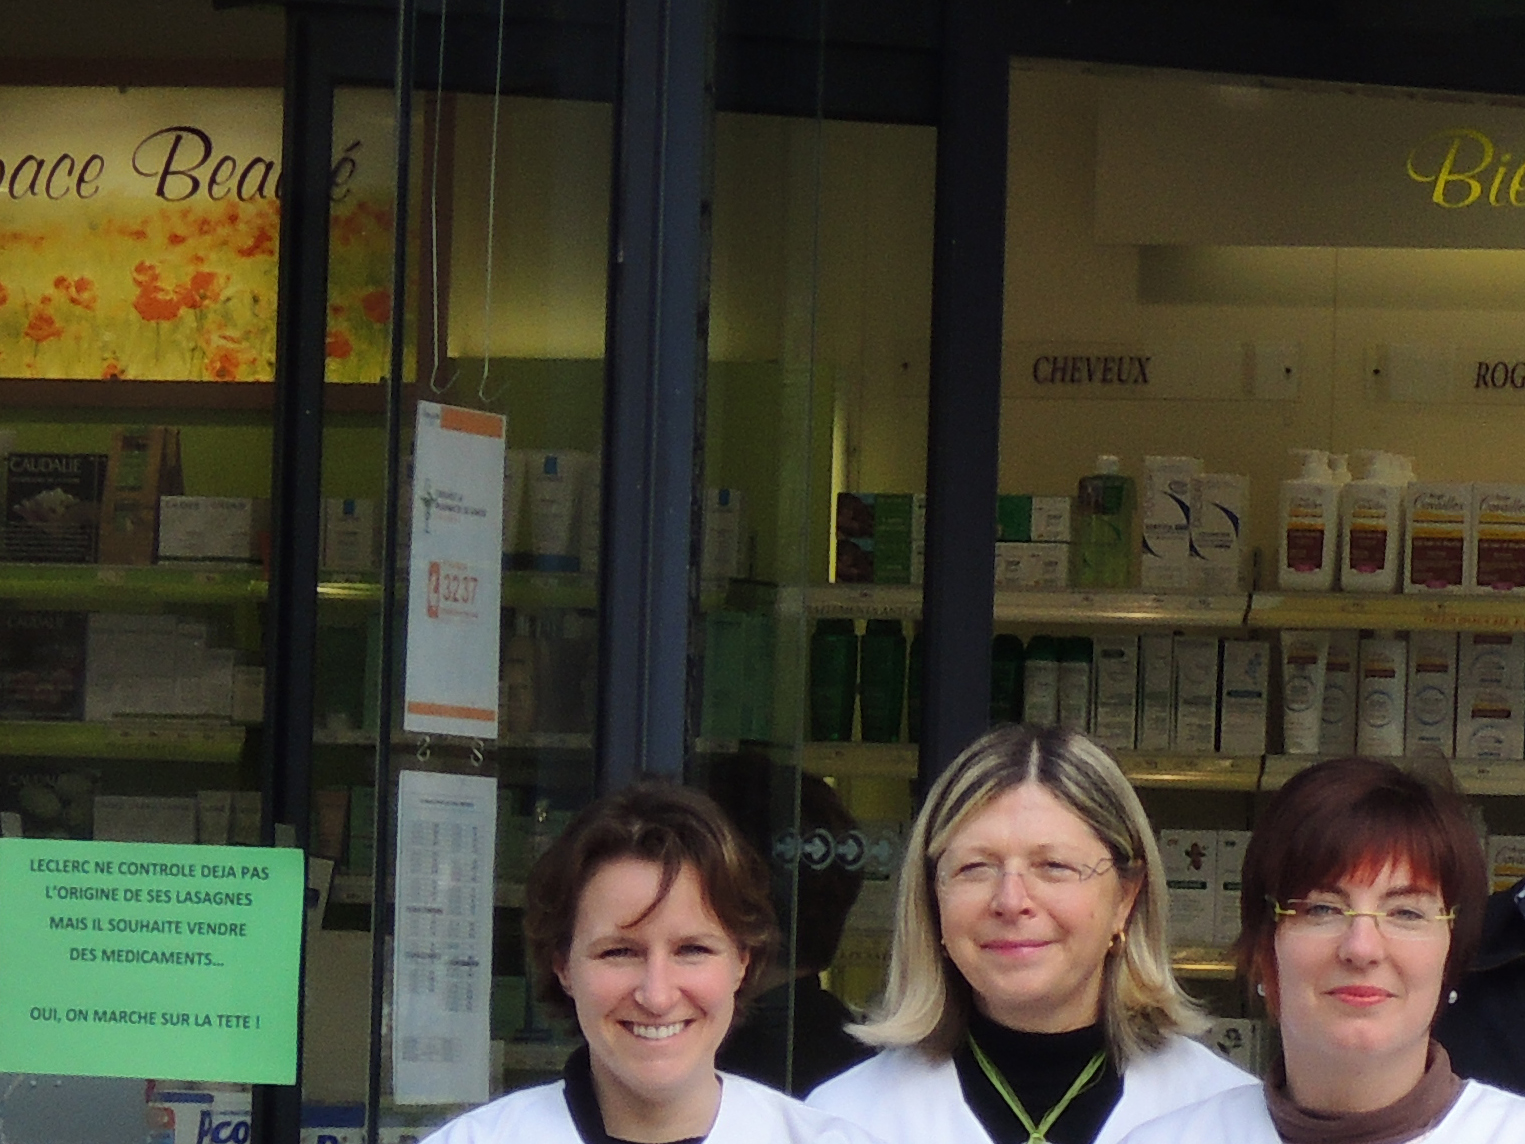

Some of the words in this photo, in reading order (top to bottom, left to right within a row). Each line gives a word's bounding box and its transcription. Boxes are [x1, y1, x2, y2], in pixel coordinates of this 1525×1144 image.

[0, 153, 105, 200] ace
[131, 125, 362, 202] Beaé
[1031, 354, 1152, 386] CHEVEUX
[10, 456, 82, 474] CAUDALIE
[30, 858, 90, 874] LECLERC
[95, 860, 114, 874] NE
[118, 861, 196, 877] CONTROLE
[201, 864, 236, 879] DEJA
[241, 866, 270, 881] PAS
[45, 885, 119, 902] L'ORIGINE
[124, 889, 143, 902] DE
[147, 889, 171, 904] SES
[176, 890, 253, 907] LASAGNES
[49, 917, 87, 931] MAIS
[92, 918, 104, 931] IL
[108, 918, 182, 934] SOUHAITE
[187, 922, 247, 937] VENDRE
[70, 948, 97, 962] DES
[101, 949, 224, 966] MEDICAMENTS...
[30, 1007, 61, 1023] OUI,
[65, 1008, 88, 1022] ON
[93, 1009, 157, 1026] MARCHE
[161, 1012, 190, 1026] SUR
[194, 1013, 213, 1027] LA
[217, 1014, 250, 1029] TETE
